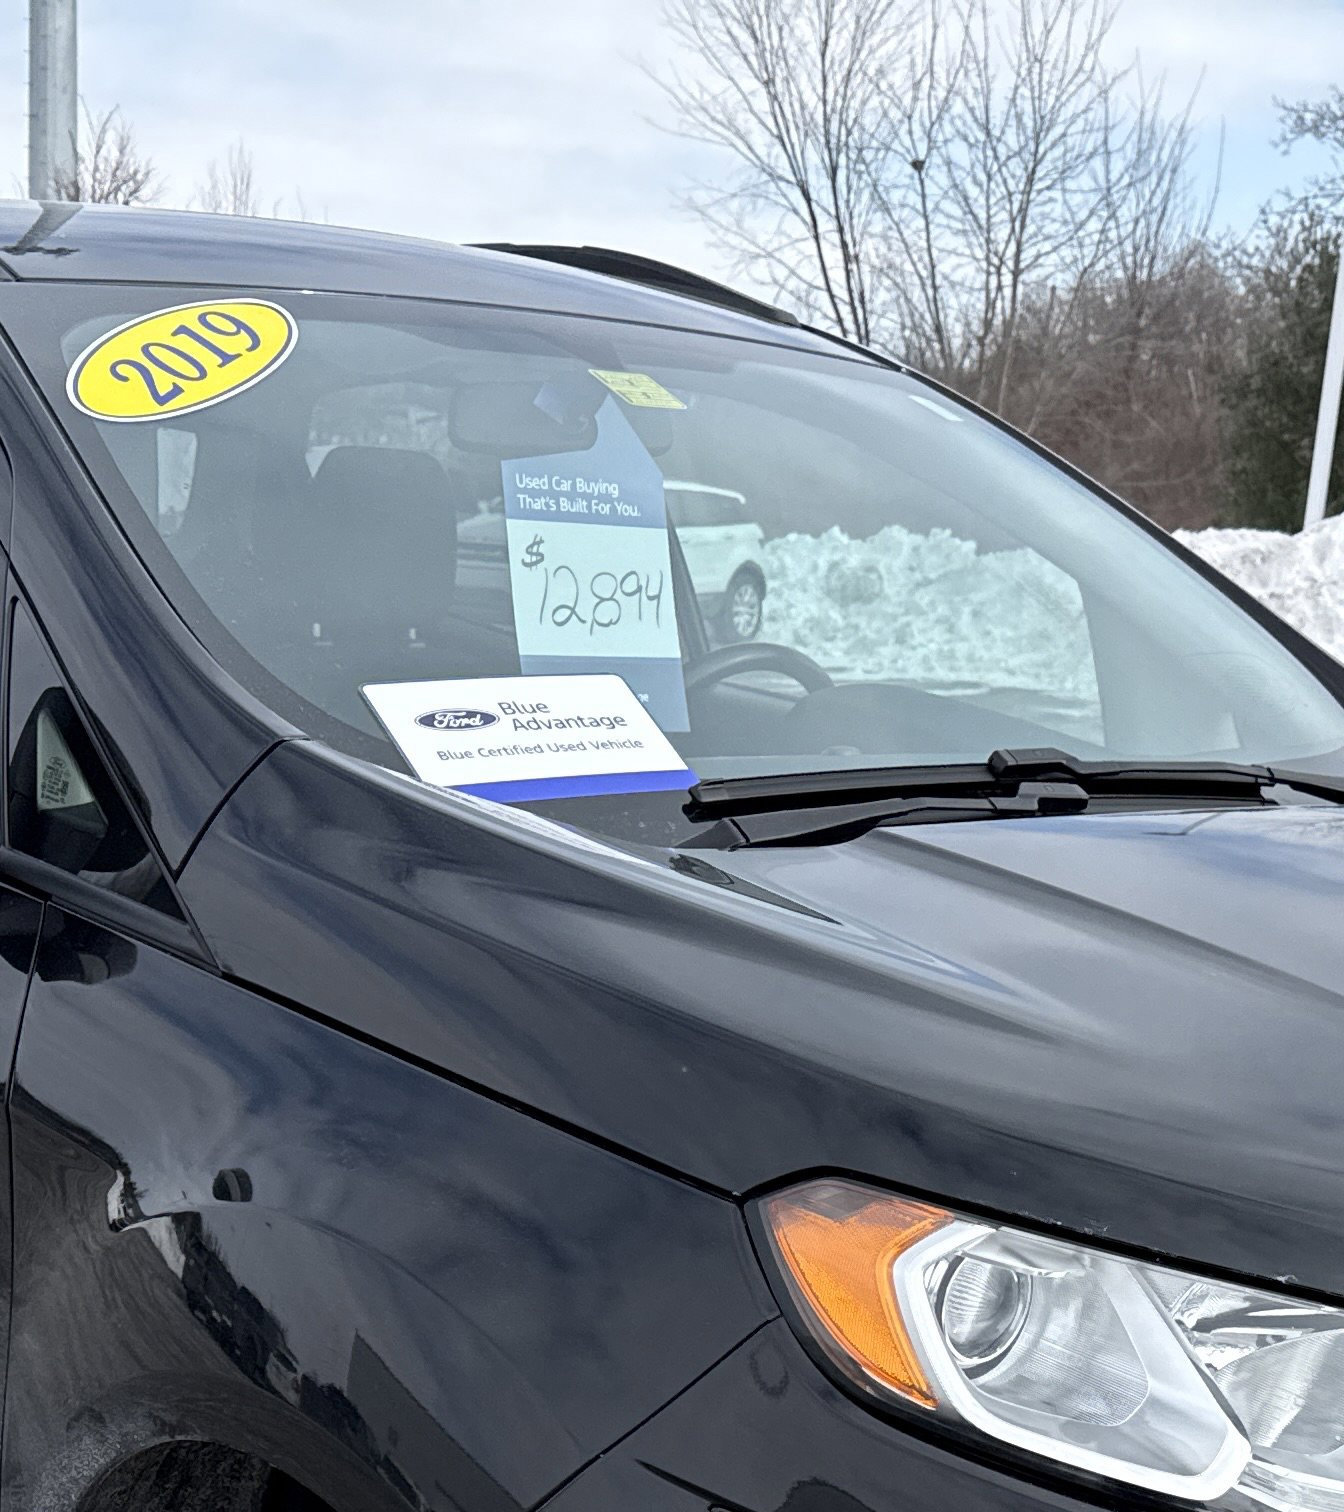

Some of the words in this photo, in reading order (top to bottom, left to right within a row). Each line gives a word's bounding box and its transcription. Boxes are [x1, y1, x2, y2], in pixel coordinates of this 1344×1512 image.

[110, 311, 261, 407] 2019
[515, 473, 548, 490] Used
[552, 476, 572, 491] Car
[576, 478, 619, 498] Buying
[516, 494, 557, 511] That's
[560, 497, 589, 514] Built
[592, 501, 611, 515] For
[614, 502, 641, 517] You.
[433, 711, 485, 728] Ford
[497, 701, 551, 716] Blue
[512, 714, 628, 732] Advantage
[436, 750, 474, 761] Blue
[478, 744, 544, 758] Certified
[546, 741, 587, 753] Used
[588, 738, 644, 750] Vehicle
